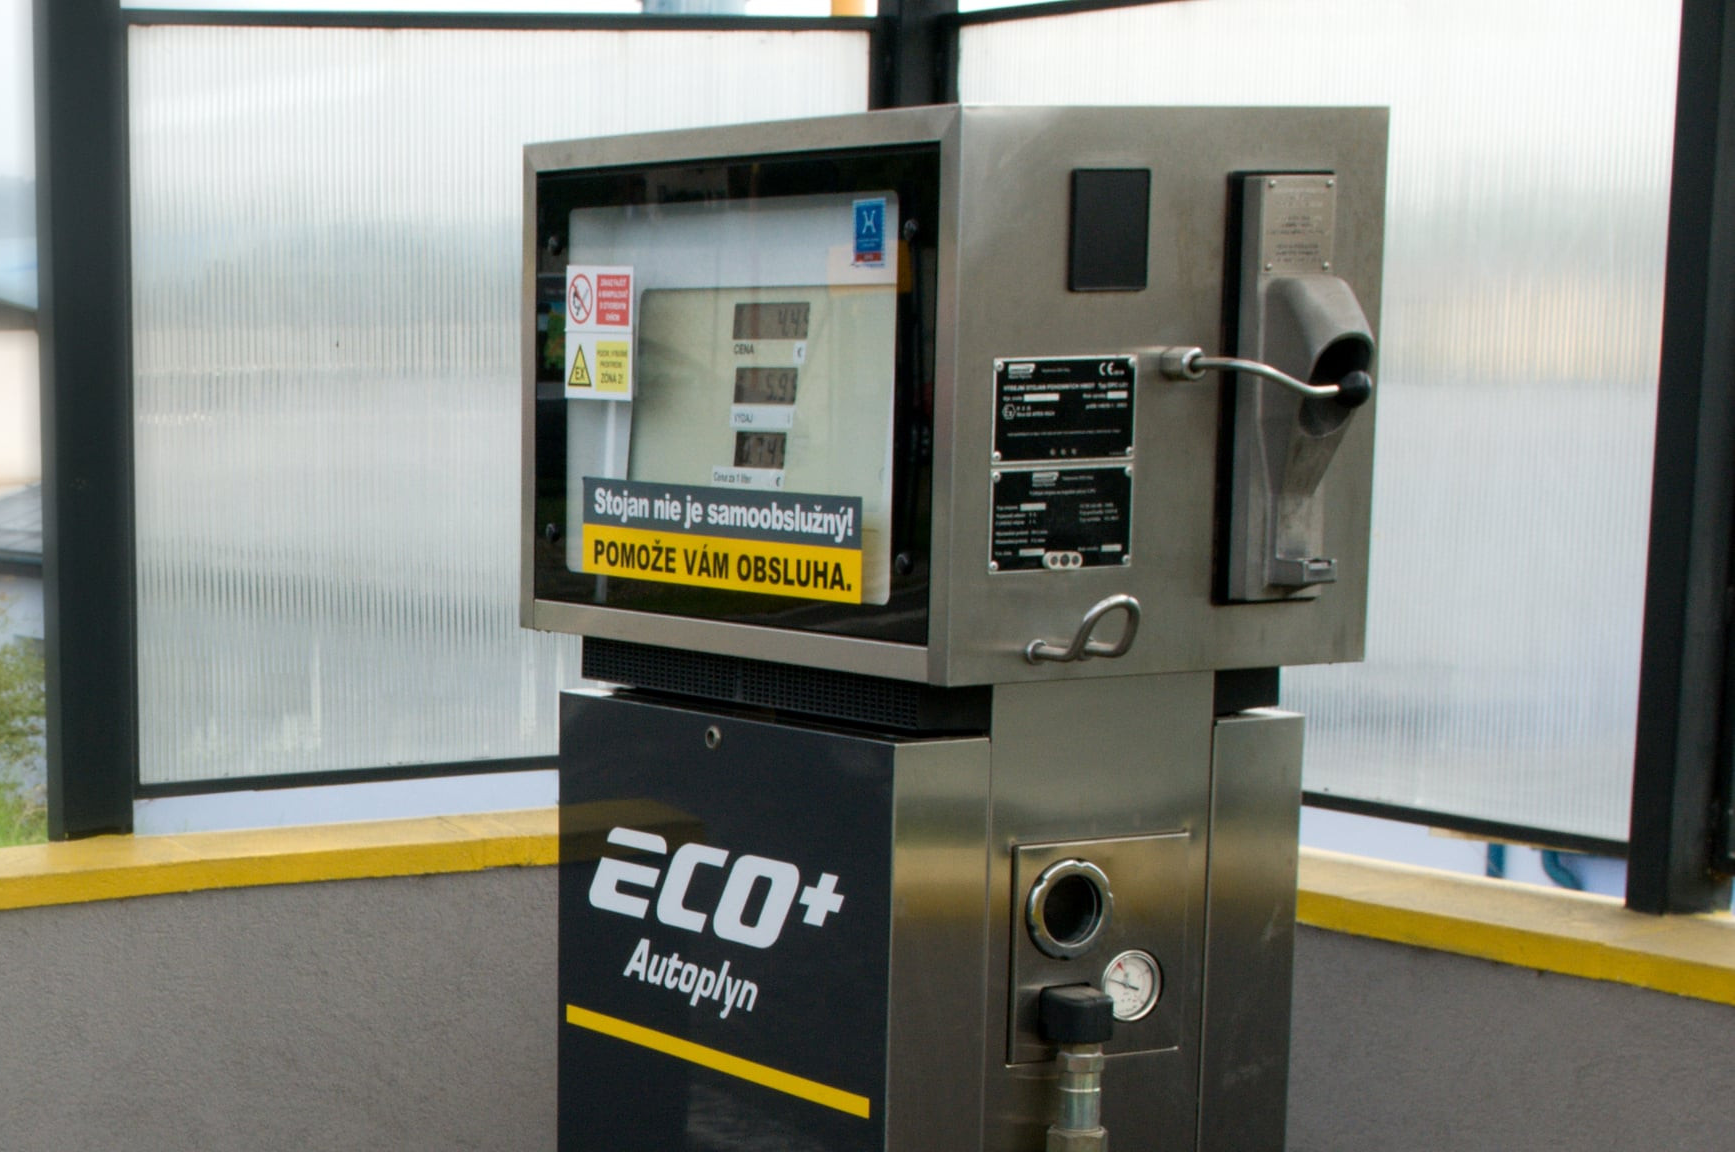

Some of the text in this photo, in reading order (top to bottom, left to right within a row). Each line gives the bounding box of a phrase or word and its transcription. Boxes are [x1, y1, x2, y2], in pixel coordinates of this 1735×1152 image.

[733, 343, 755, 355] CENA
[594, 487, 854, 543] Stojan nie je samoobslužný!
[594, 539, 852, 592] POMOŽE VÁM OBSLUHA.
[589, 827, 844, 949] ECO+
[623, 938, 758, 1019] Autoplyn
